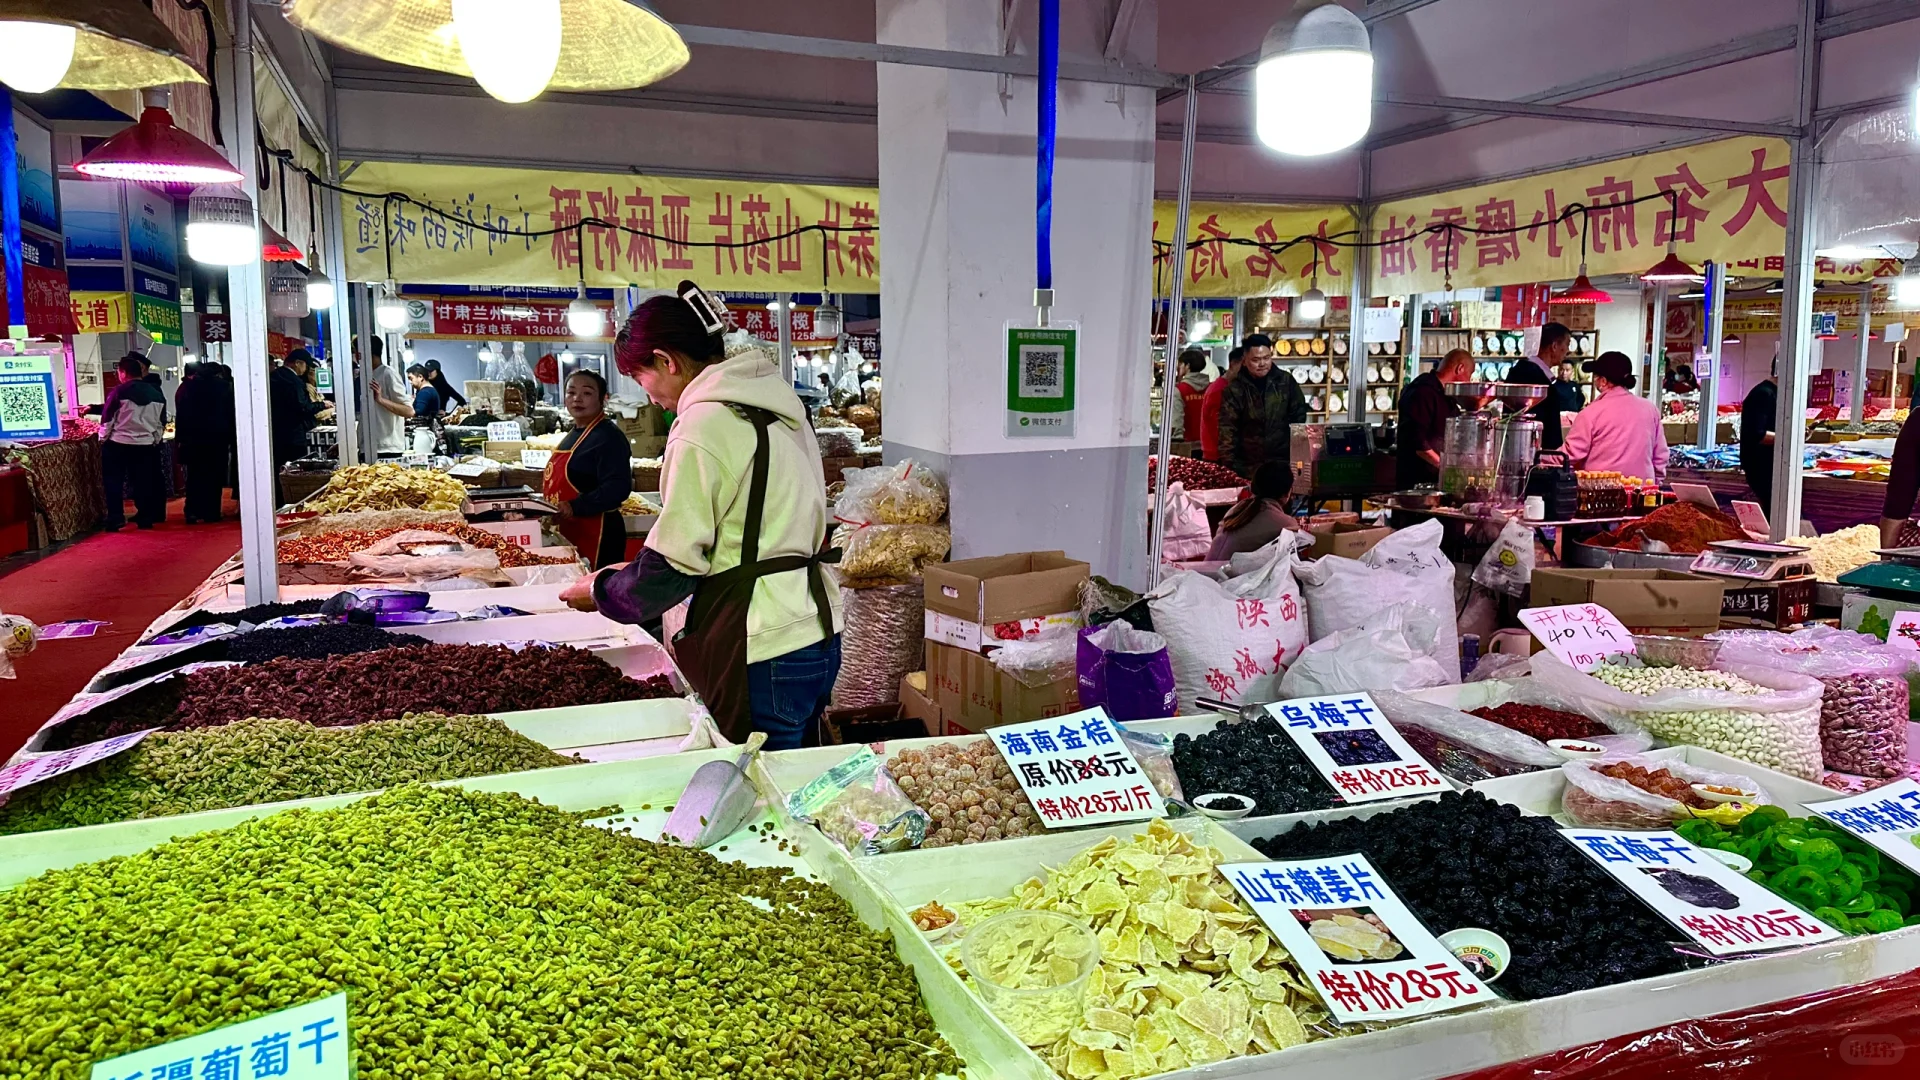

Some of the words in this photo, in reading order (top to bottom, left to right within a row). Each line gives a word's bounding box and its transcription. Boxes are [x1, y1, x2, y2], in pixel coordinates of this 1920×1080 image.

[205, 319, 227, 339] 茶
[1032, 418, 1062, 426] 微信支付
[1236, 594, 1297, 630] 陕西
[1530, 606, 1617, 628] 开心果
[1281, 699, 1374, 729] 乌梅干
[1000, 717, 1114, 756] 海南金桔
[1018, 751, 1137, 788] 原价88元
[1332, 764, 1440, 795] 特价28元
[1036, 785, 1153, 821] 特价28元/斤
[1573, 835, 1698, 865] 西梅干
[1235, 862, 1386, 905] 山东糖姜片
[1679, 909, 1822, 946] 特价28元
[1317, 962, 1478, 1013] 特价28元
